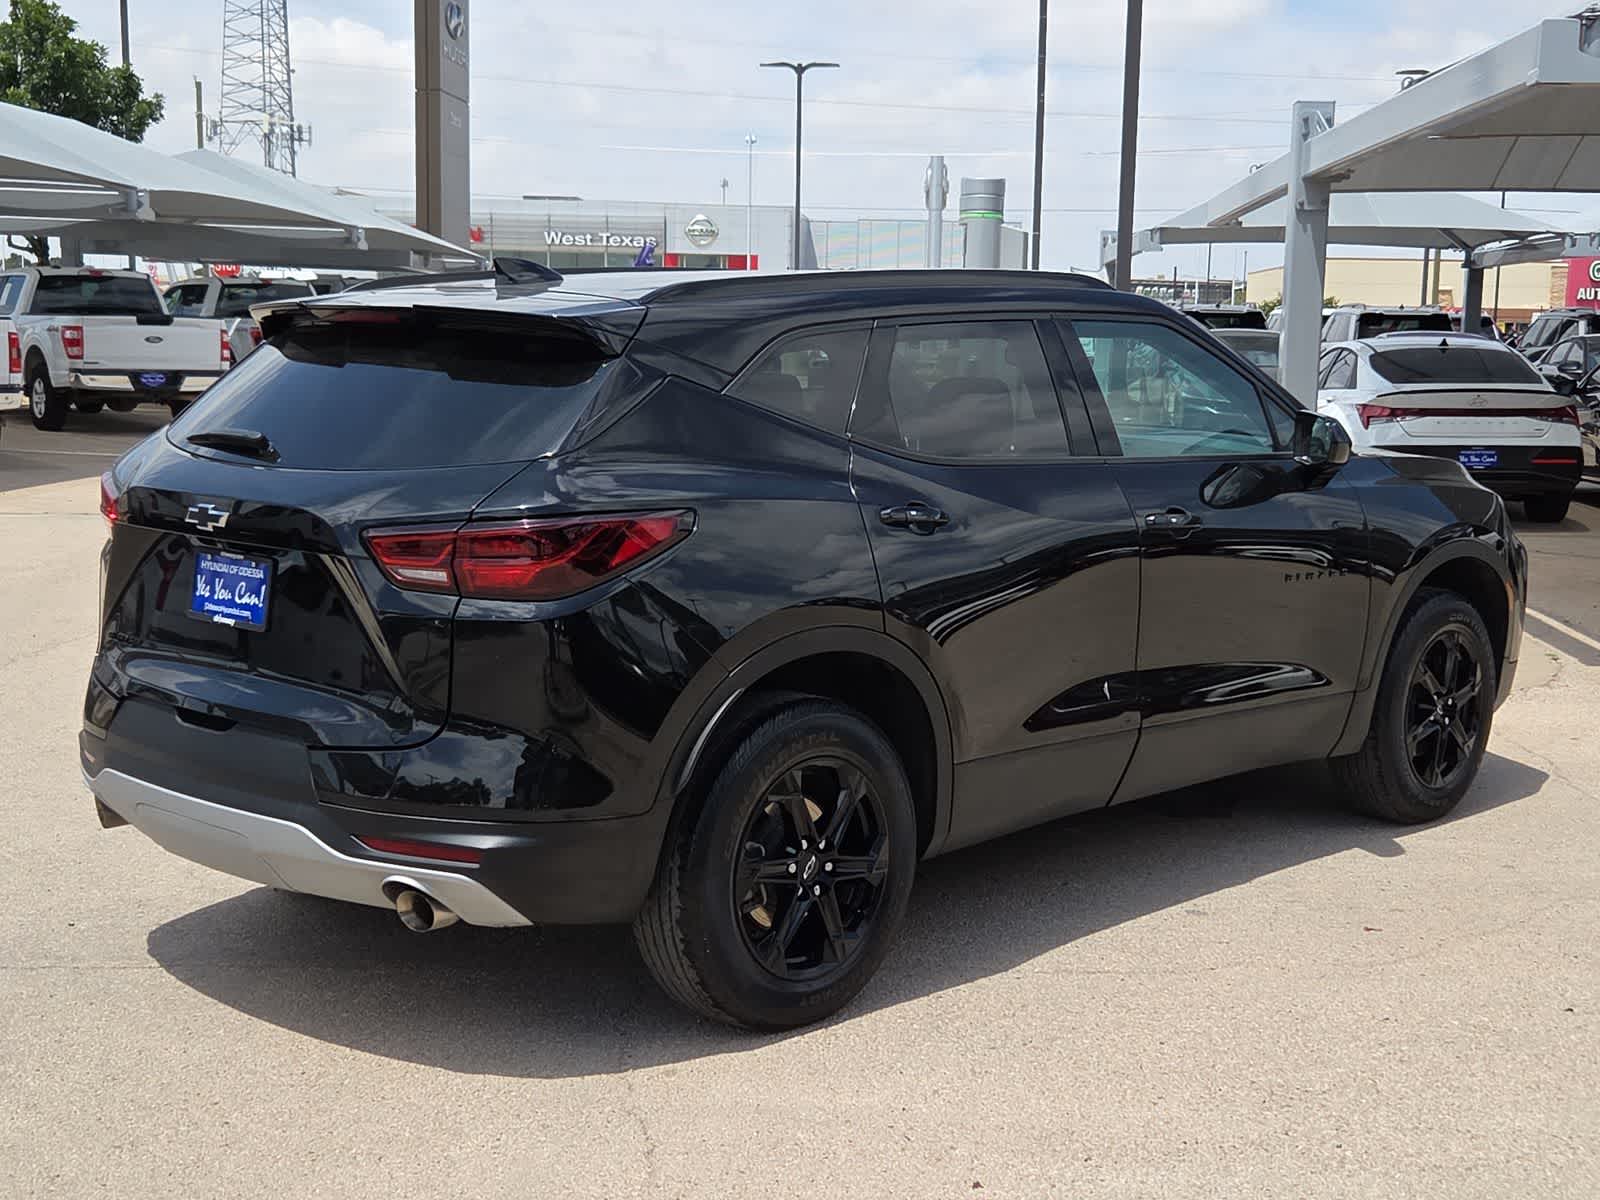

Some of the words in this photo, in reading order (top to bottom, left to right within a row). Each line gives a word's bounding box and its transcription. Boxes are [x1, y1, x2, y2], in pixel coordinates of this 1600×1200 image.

[544, 231, 593, 246] West
[599, 232, 657, 248] Texas
[201, 560, 229, 573] HYUNDAI
[229, 565, 238, 575] OF
[238, 566, 264, 579] ODESSA
[196, 574, 210, 597] Yes
[214, 577, 232, 600] You
[235, 581, 266, 607] Can!
